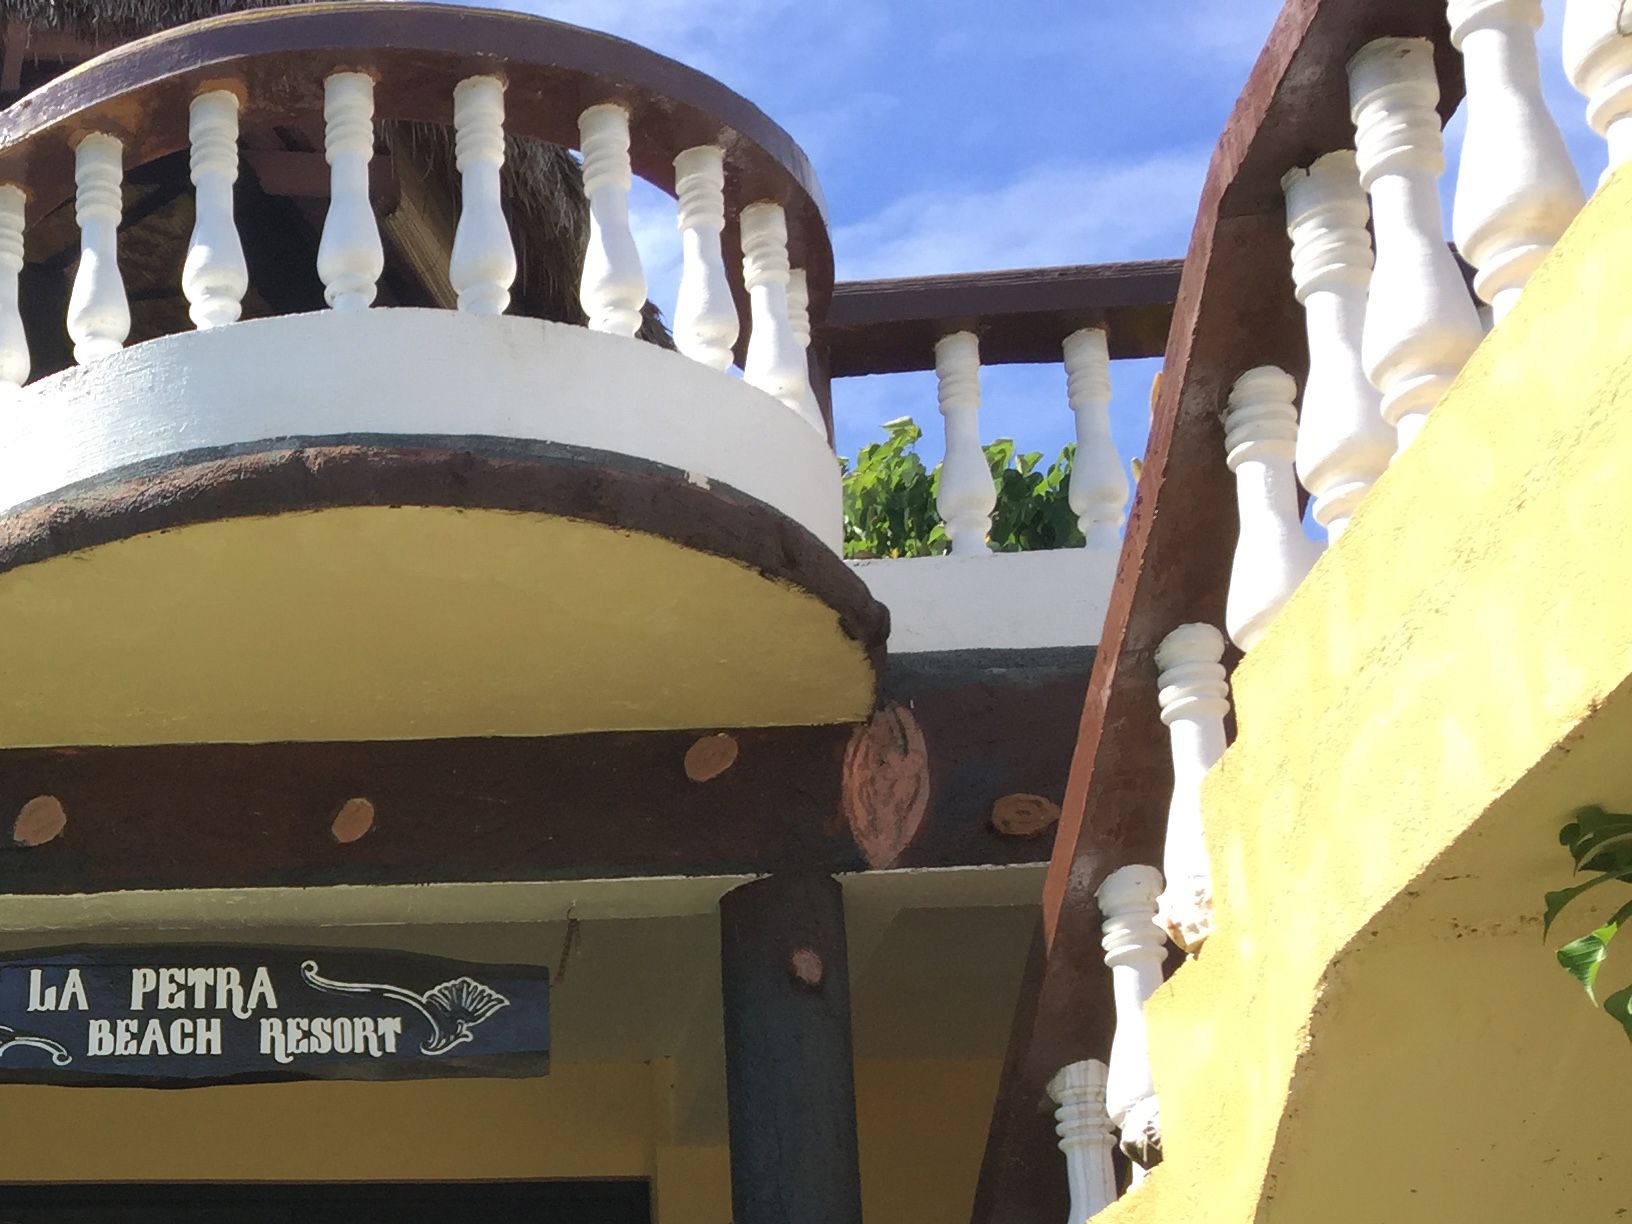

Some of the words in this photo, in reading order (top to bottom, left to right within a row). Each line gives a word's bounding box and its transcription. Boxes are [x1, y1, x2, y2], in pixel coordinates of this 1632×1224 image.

[26, 968, 89, 1012] LA
[129, 966, 278, 1020] PETRA
[86, 1017, 222, 1057] BEACH
[259, 1016, 402, 1064] RESORT
